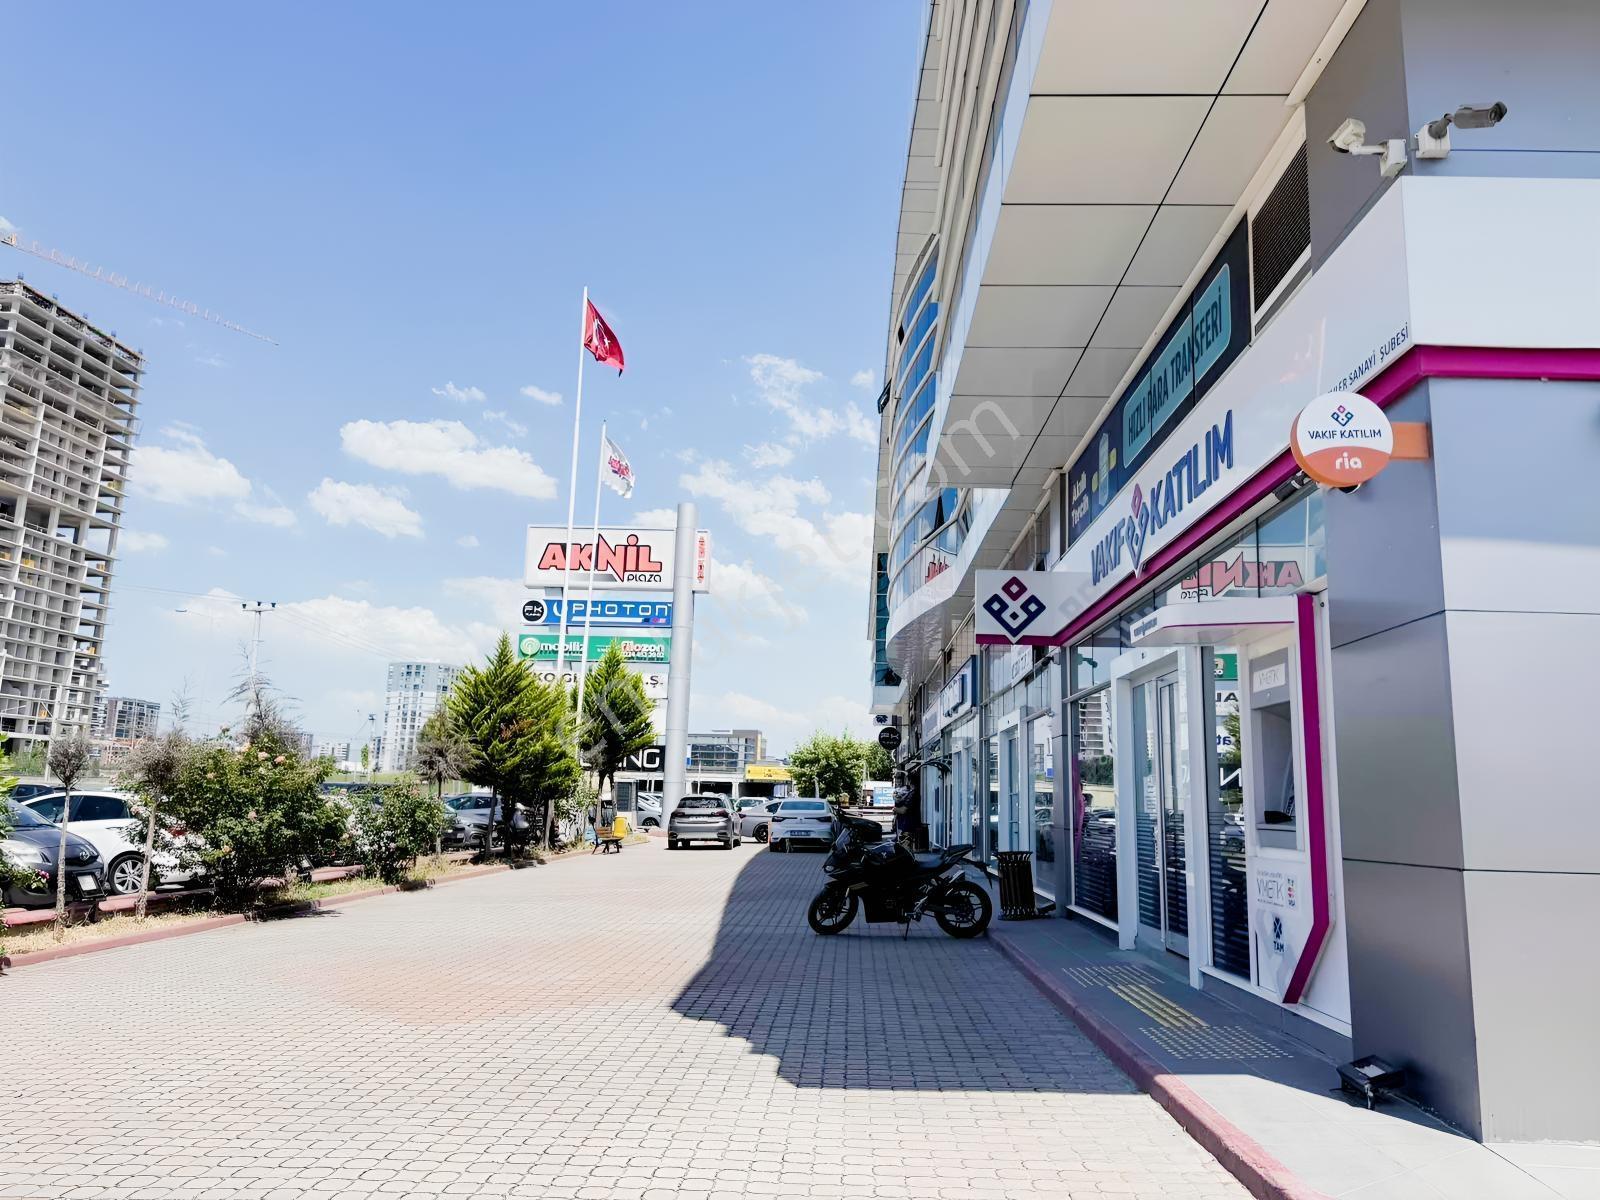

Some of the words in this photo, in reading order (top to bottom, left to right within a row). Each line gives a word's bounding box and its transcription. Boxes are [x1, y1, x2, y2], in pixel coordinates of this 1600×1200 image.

[1128, 397, 1146, 447] HIZLI
[1147, 367, 1169, 423] PARA
[1170, 287, 1222, 393] TRANSFERİ
[1349, 350, 1376, 386] SANAYİ
[1380, 321, 1409, 363] ŞUBESİ
[1307, 430, 1338, 440] VAKIF
[1339, 429, 1382, 439] KATILIM
[1335, 451, 1362, 470] ria
[1090, 517, 1126, 587] VAKIF
[1150, 409, 1234, 536] KATILIM
[626, 572, 662, 583] plaza
